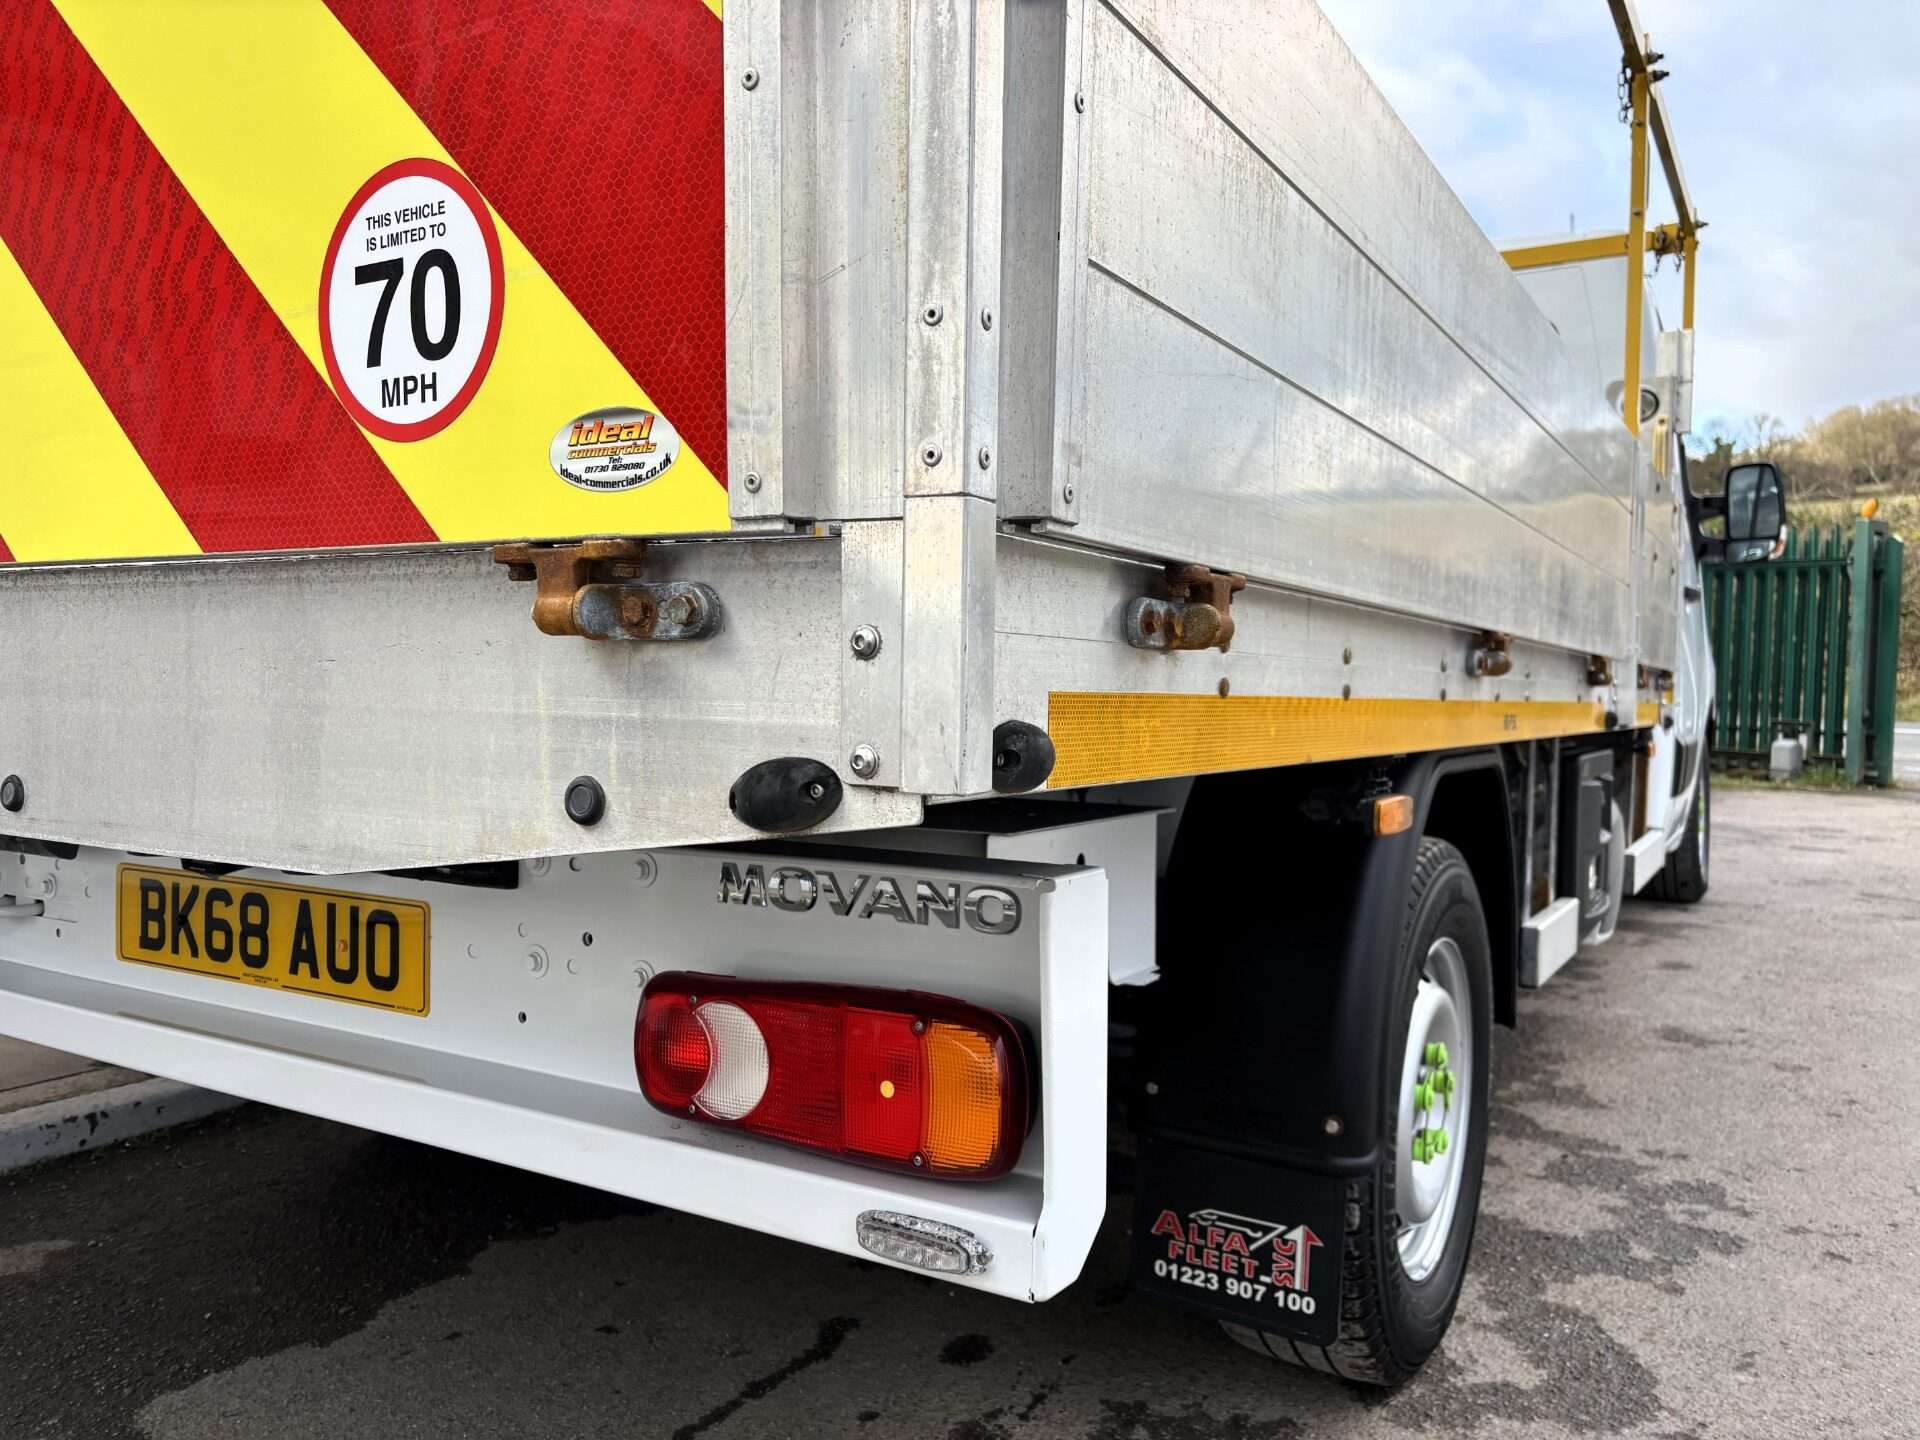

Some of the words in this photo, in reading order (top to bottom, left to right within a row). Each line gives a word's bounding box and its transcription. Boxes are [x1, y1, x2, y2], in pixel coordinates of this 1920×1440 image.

[365, 212, 392, 231] THIS
[394, 200, 446, 225] VEHICLE
[366, 236, 377, 252] IS
[380, 227, 427, 249] LIMITED
[429, 222, 446, 240] TO
[354, 248, 461, 369] 70
[381, 372, 437, 408] MPH
[568, 415, 655, 447] ideal
[567, 441, 657, 460] commercials
[584, 464, 609, 474] 01730
[611, 462, 645, 472] 829080
[608, 456, 623, 465] Tel:
[560, 452, 672, 489] ideal-commercials.co.uk
[716, 861, 1023, 935] MOVANO
[138, 877, 270, 970] BK68
[288, 898, 401, 992] AUO
[1151, 1209, 1250, 1257] ALFA
[1154, 1259, 1220, 1291] 01223
[1225, 1277, 1267, 1302] 907
[1273, 1290, 1316, 1315] 100
